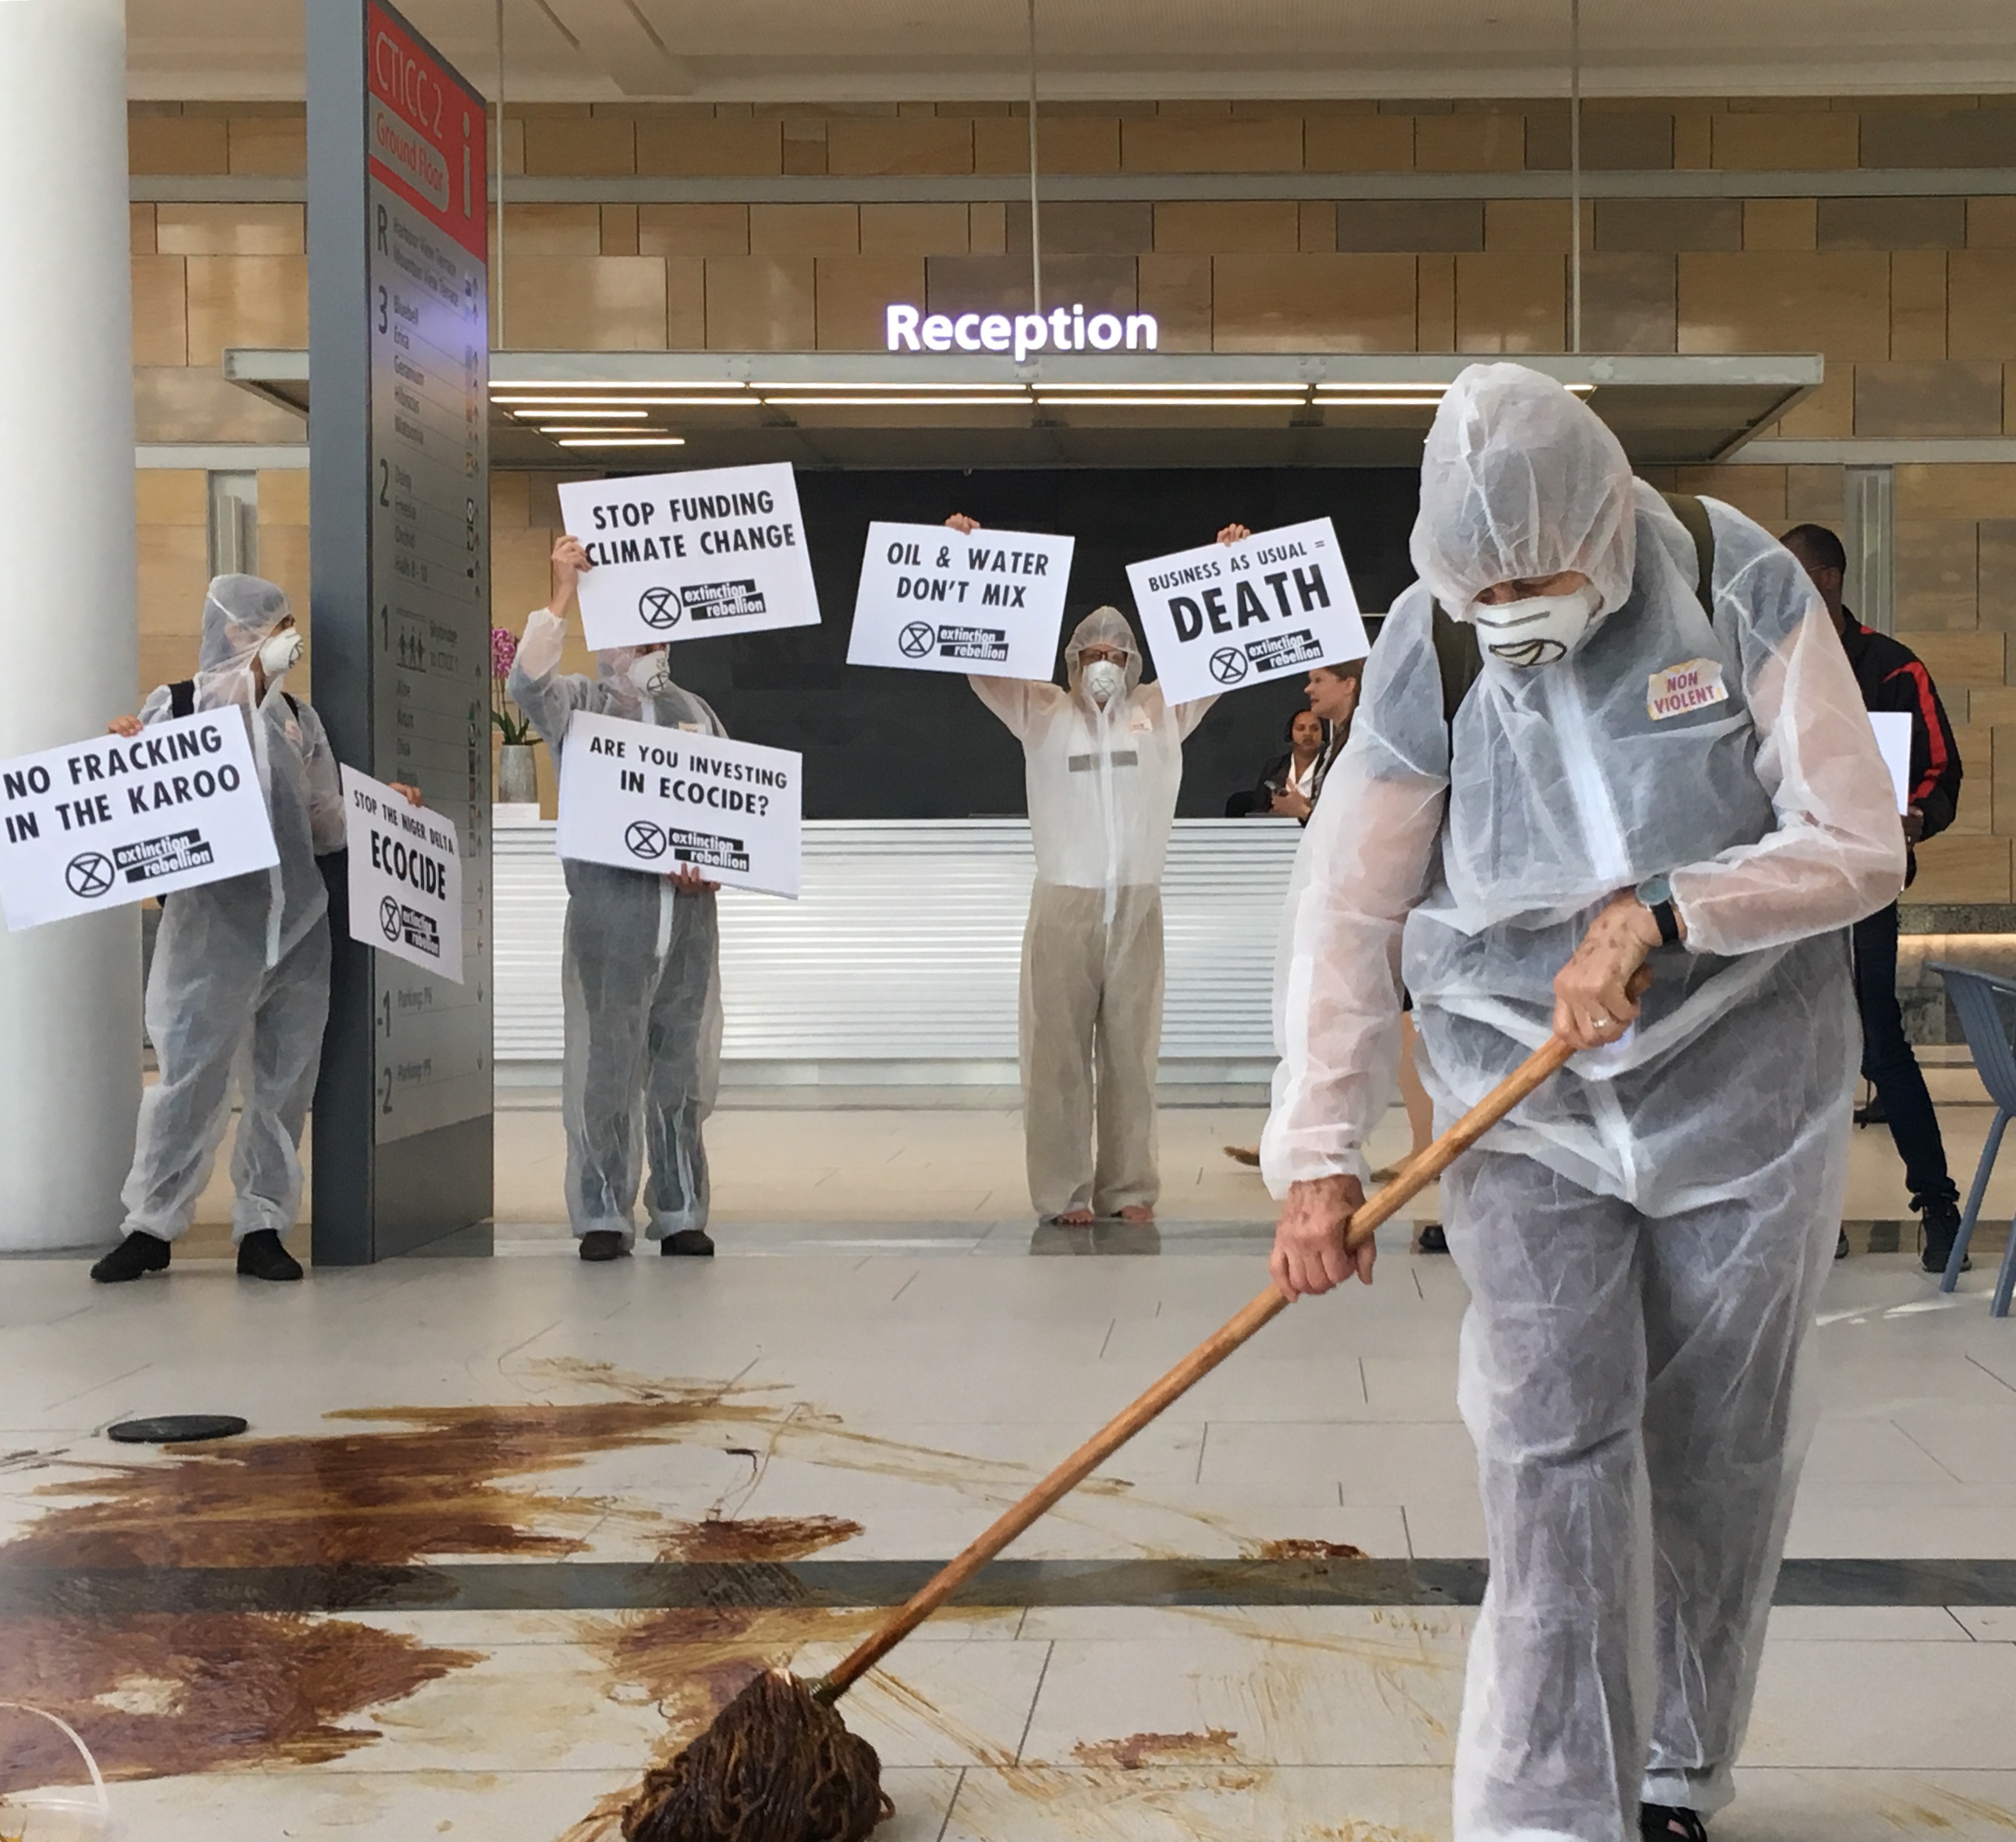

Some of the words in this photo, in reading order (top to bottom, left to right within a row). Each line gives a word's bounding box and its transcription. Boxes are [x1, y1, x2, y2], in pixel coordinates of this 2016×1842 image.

[377, 31, 428, 126] CTICC
[433, 83, 442, 139] 2
[377, 112, 416, 167] Ground
[416, 142, 443, 191] Floor
[377, 205, 389, 256] R
[378, 285, 388, 335] 3
[887, 304, 1158, 362] Reception
[380, 458, 389, 507] 2
[593, 502, 655, 530] STOP
[669, 490, 774, 522] FUNDING
[586, 534, 687, 567] CLIMATE
[700, 524, 795, 555] CHANGE
[887, 542, 920, 566] OIL
[936, 546, 951, 568] &
[968, 548, 1048, 576] WATER
[1148, 561, 1221, 592] BUSINESS
[1231, 555, 1250, 572] AS
[1257, 541, 1307, 564] USUAL
[684, 583, 747, 603] extinction
[706, 596, 763, 617] rebellion
[897, 577, 969, 603] DON'T
[982, 583, 1027, 608] MIX
[1168, 564, 1331, 643] DEATH
[380, 604, 388, 652] 1
[940, 628, 996, 643] extinction
[1248, 633, 1305, 657] extinction
[954, 643, 1006, 660] rebellion
[1269, 644, 1321, 669] rebellion
[1654, 685, 1714, 714] VIOLENT
[1667, 671, 1698, 692] NON
[3, 766, 50, 800] NO
[67, 725, 222, 785] FRACKING
[590, 736, 625, 758] ARE
[638, 745, 678, 768] YOU
[690, 755, 787, 789] INVESTING
[5, 811, 40, 843] IN
[55, 794, 112, 831] THE
[127, 764, 240, 815] KAROO
[620, 770, 645, 794] IN
[660, 778, 769, 816] ECOCIDE?
[354, 790, 377, 815] STOP
[382, 804, 398, 826] THE
[401, 813, 426, 841] NIGER
[429, 828, 454, 855] DELTA
[672, 831, 734, 851] extinction
[117, 834, 190, 865] extinction
[144, 848, 211, 878] rebellion
[371, 829, 446, 900] ECOCIDE
[691, 849, 747, 870] rebellion
